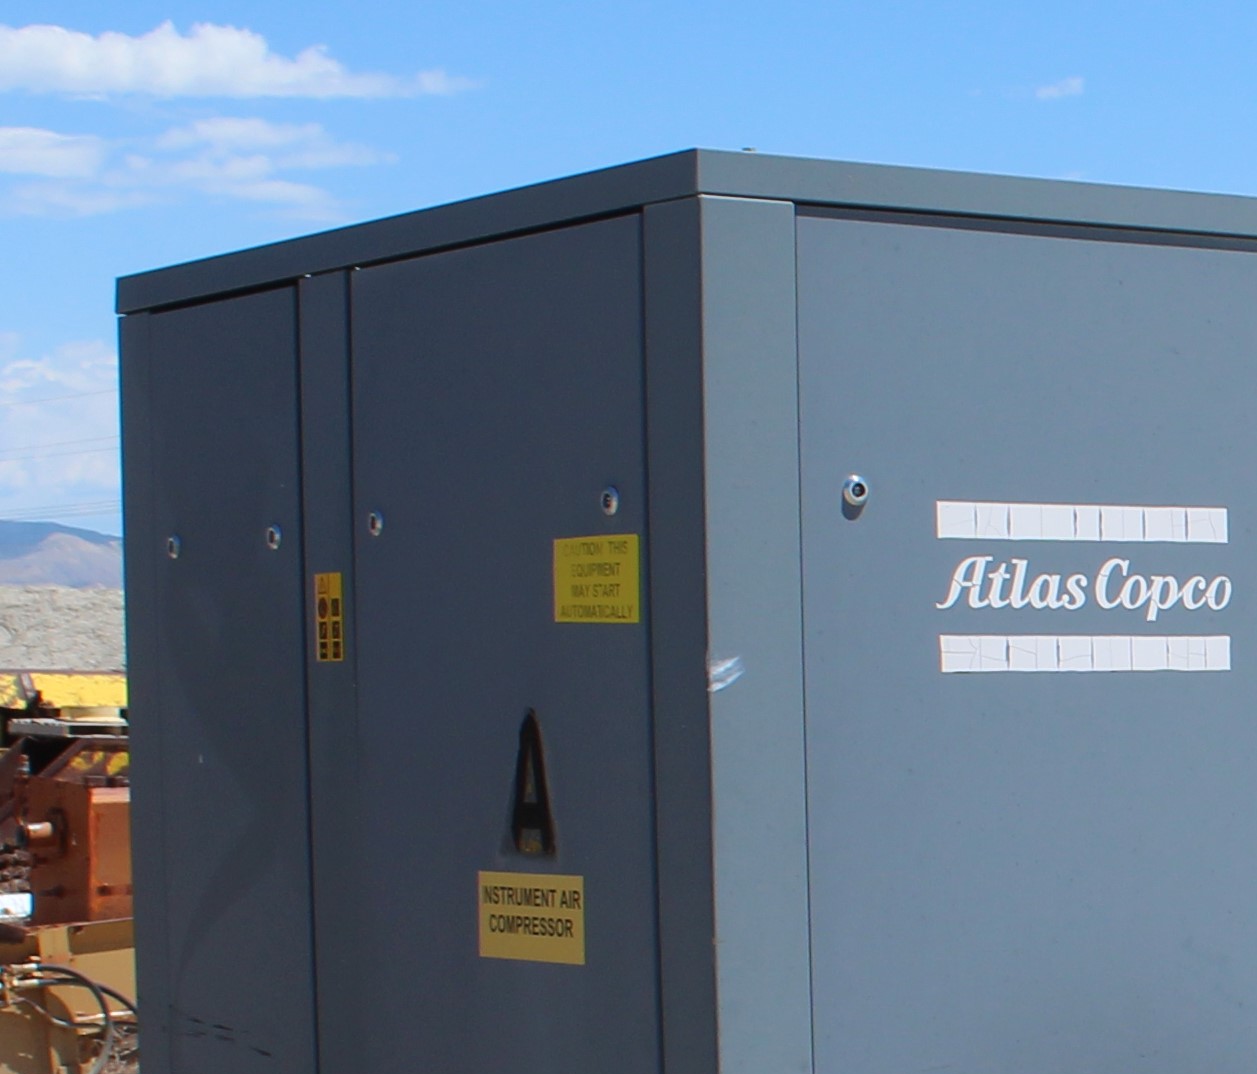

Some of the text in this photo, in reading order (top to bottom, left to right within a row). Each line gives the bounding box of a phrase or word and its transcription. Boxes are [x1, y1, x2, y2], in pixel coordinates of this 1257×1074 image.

[608, 540, 629, 555] THIS
[571, 583, 621, 598] MAY START
[935, 555, 1232, 622] Atlas Copco
[560, 604, 634, 619] AUTOMATICALLY
[510, 706, 557, 858] A
[560, 890, 581, 910] AIR
[489, 914, 574, 938] COMPRESSOR
